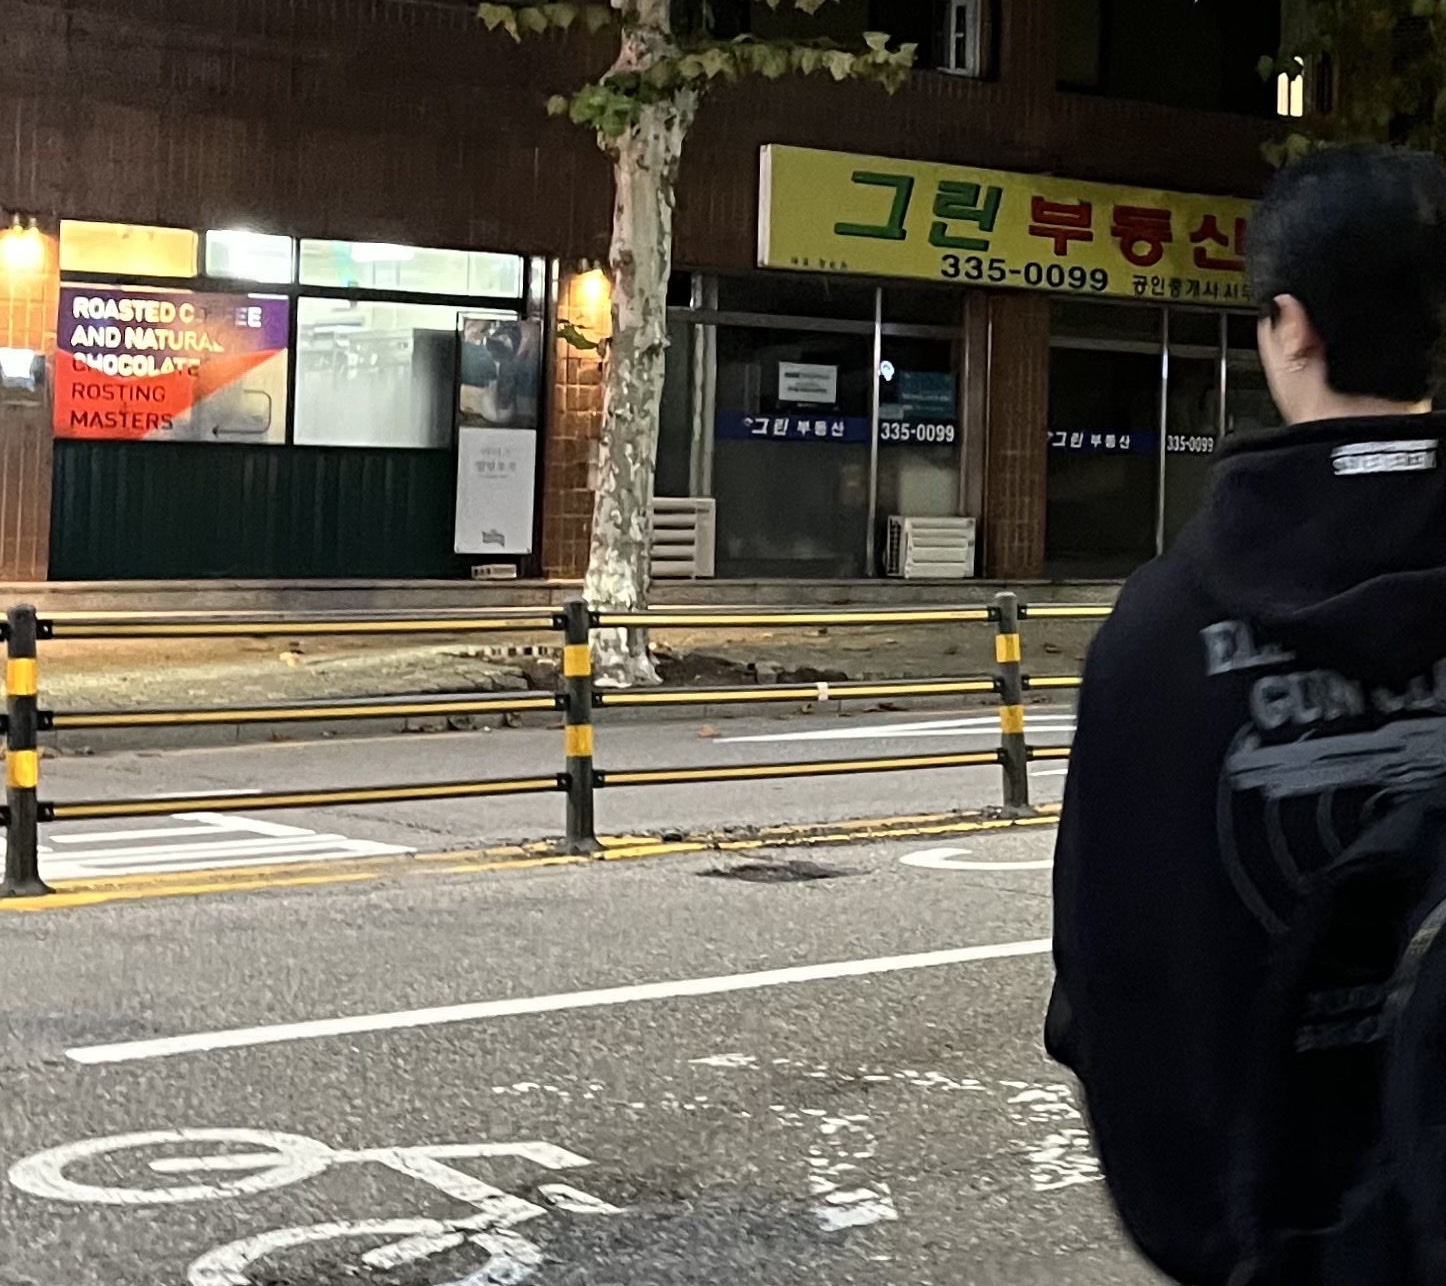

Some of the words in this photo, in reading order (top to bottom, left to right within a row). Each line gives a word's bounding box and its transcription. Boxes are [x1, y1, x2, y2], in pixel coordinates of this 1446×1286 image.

[833, 170, 1003, 253] 그린
[1028, 195, 1248, 272] 부동산
[940, 253, 1109, 292] 335-0099
[72, 296, 176, 324] ROASTED
[70, 324, 122, 348] AND
[71, 382, 167, 403] ROSTING
[70, 409, 174, 431] MASTERS
[751, 417, 790, 437] 그린
[796, 420, 845, 437] 부동산
[880, 422, 955, 443] 335-0099
[1051, 431, 1084, 448] 그린
[1166, 434, 1214, 453] 335-0099
